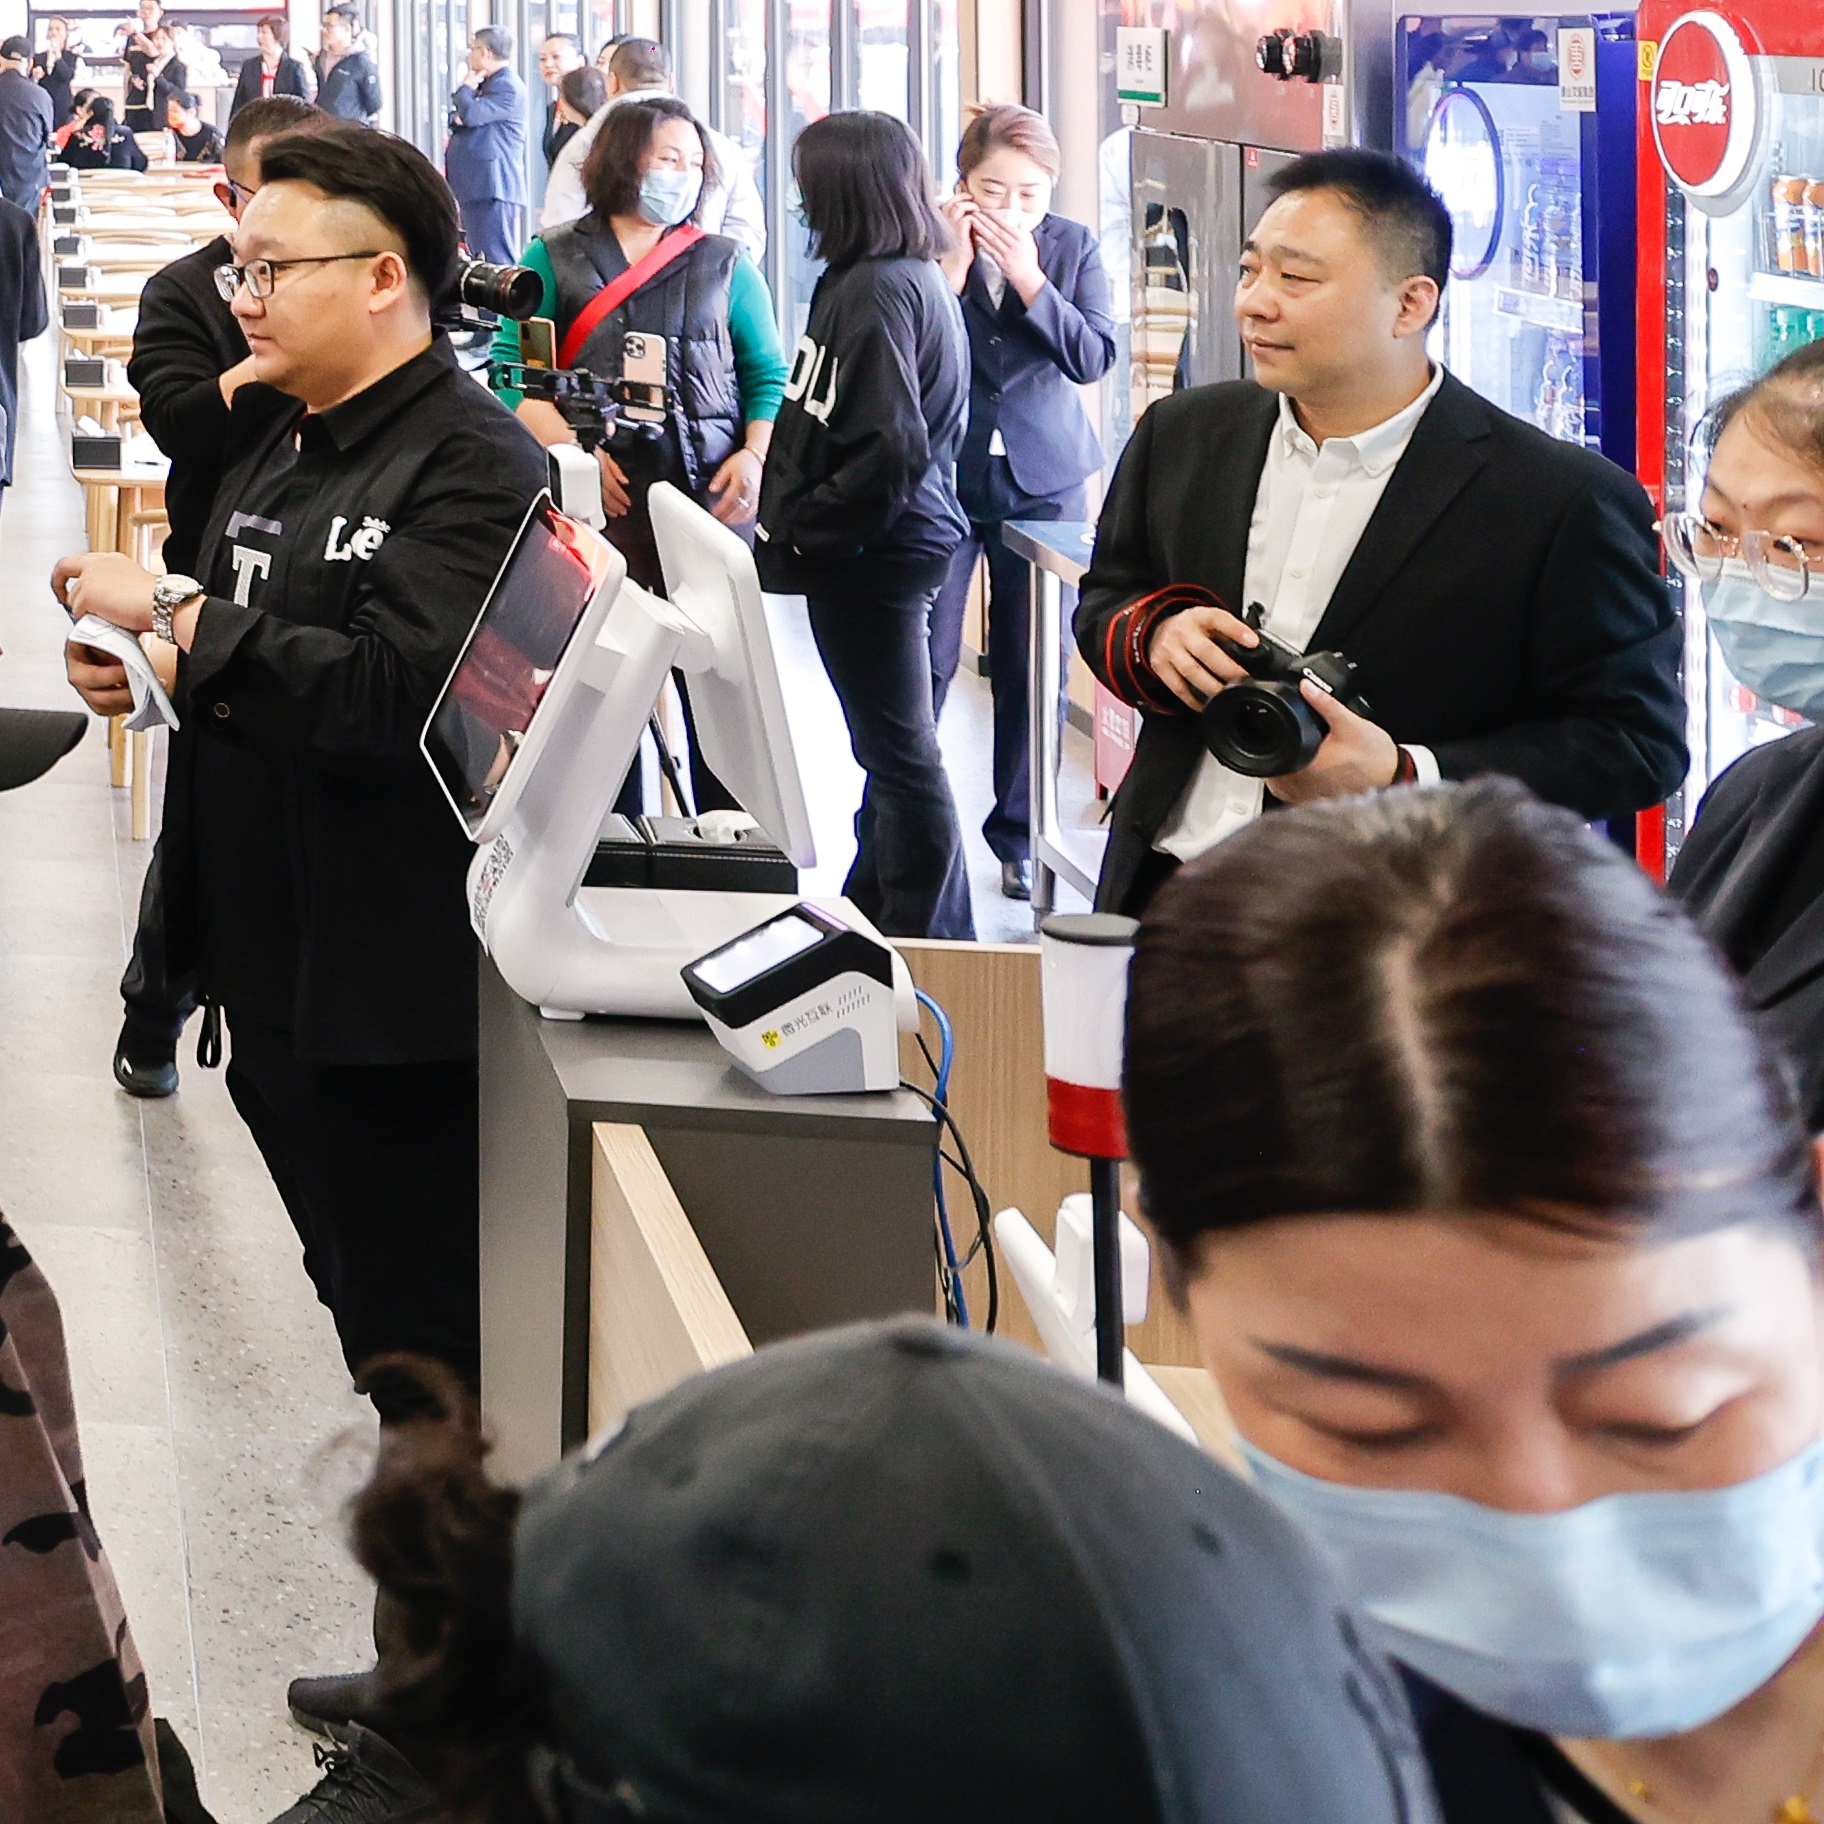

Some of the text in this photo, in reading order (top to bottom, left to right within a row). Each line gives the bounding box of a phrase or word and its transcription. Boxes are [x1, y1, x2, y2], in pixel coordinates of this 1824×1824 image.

[1655, 78, 1730, 126] 可口可乐
[781, 1001, 834, 1037] 微光互联
